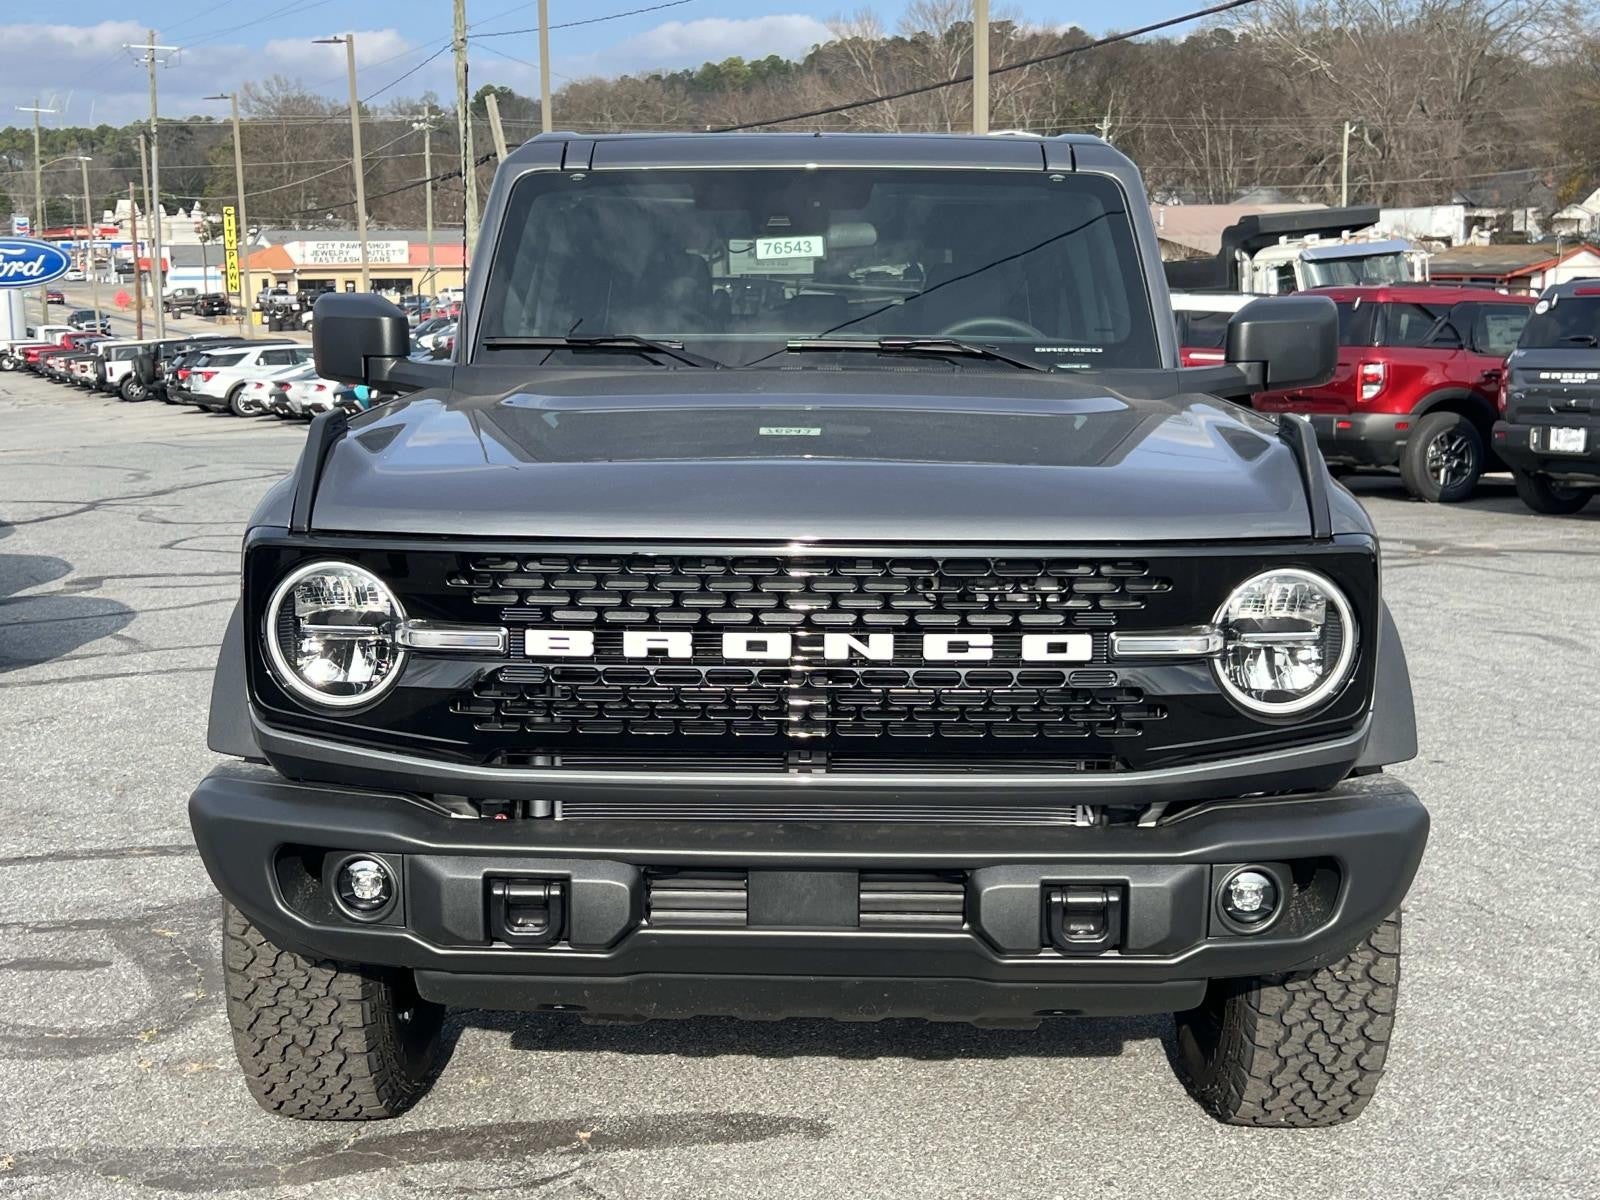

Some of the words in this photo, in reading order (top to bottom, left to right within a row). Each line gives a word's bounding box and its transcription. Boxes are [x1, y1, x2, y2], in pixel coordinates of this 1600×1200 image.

[225, 208, 234, 247] CITY
[763, 241, 812, 255] 76543
[229, 252, 237, 290] PAWN
[524, 629, 1092, 661] BRONCO
